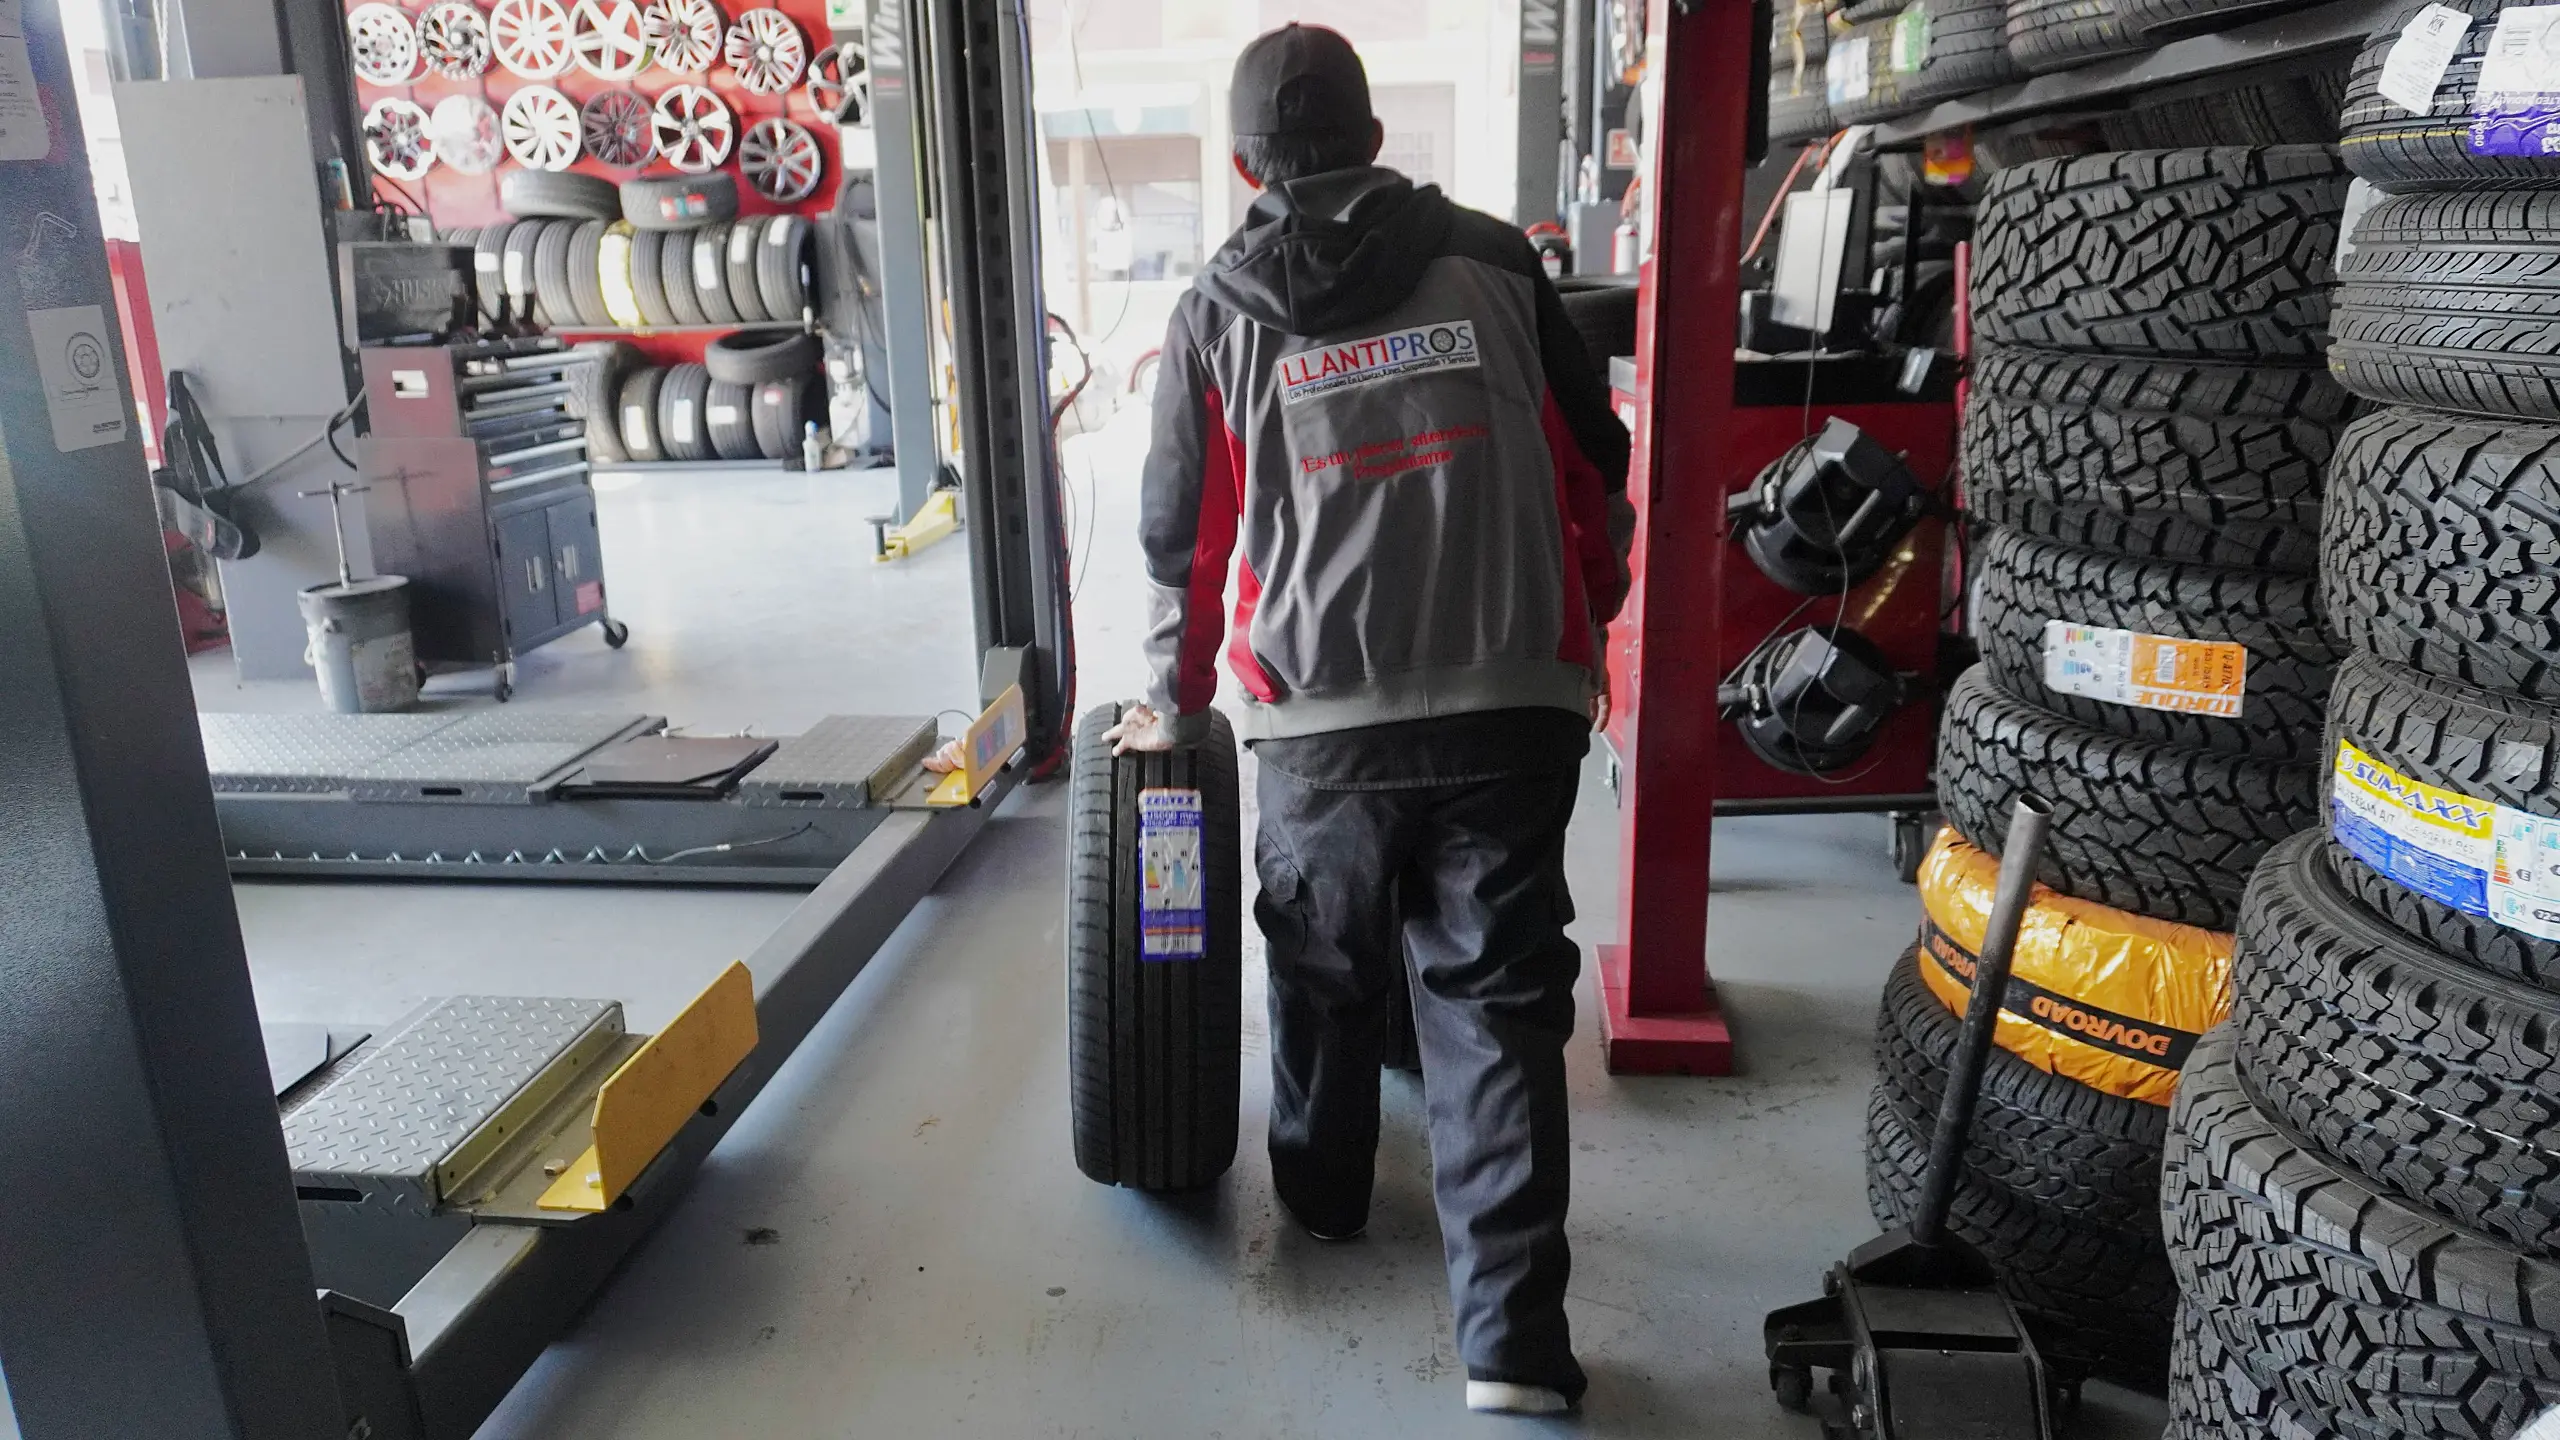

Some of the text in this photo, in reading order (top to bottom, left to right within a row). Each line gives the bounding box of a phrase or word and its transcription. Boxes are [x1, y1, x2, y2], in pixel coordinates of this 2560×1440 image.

[869, 0, 902, 68] Win
[1281, 326, 1474, 387] LLANTIPROS
[1288, 390, 1303, 400] Los
[1302, 379, 1348, 396] Profesionales
[2351, 761, 2491, 829] SUMAXX
[1931, 935, 1977, 981] VROAD
[2031, 995, 2173, 1057] DOVROAD
